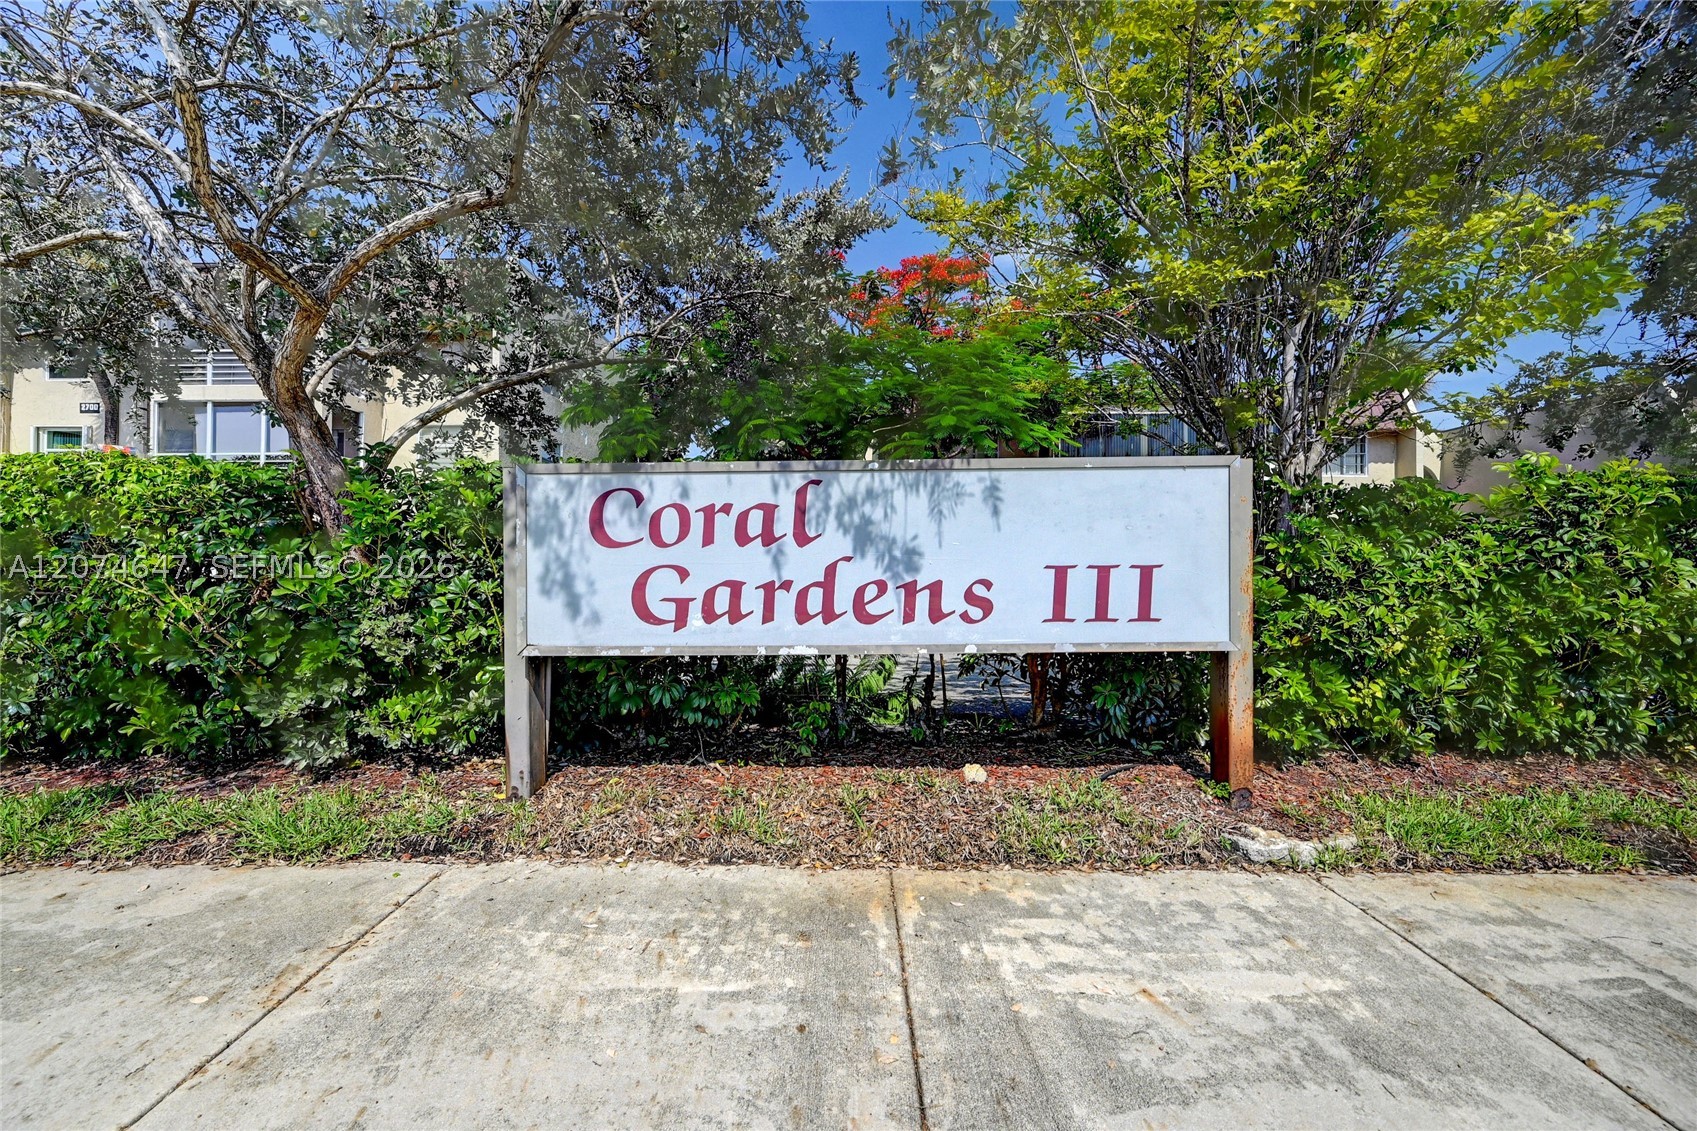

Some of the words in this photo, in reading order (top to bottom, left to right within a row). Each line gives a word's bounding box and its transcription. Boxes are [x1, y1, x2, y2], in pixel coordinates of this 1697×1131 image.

[588, 479, 823, 549] Coral
[630, 556, 995, 632] Gardens
[1041, 564, 1164, 623] III
